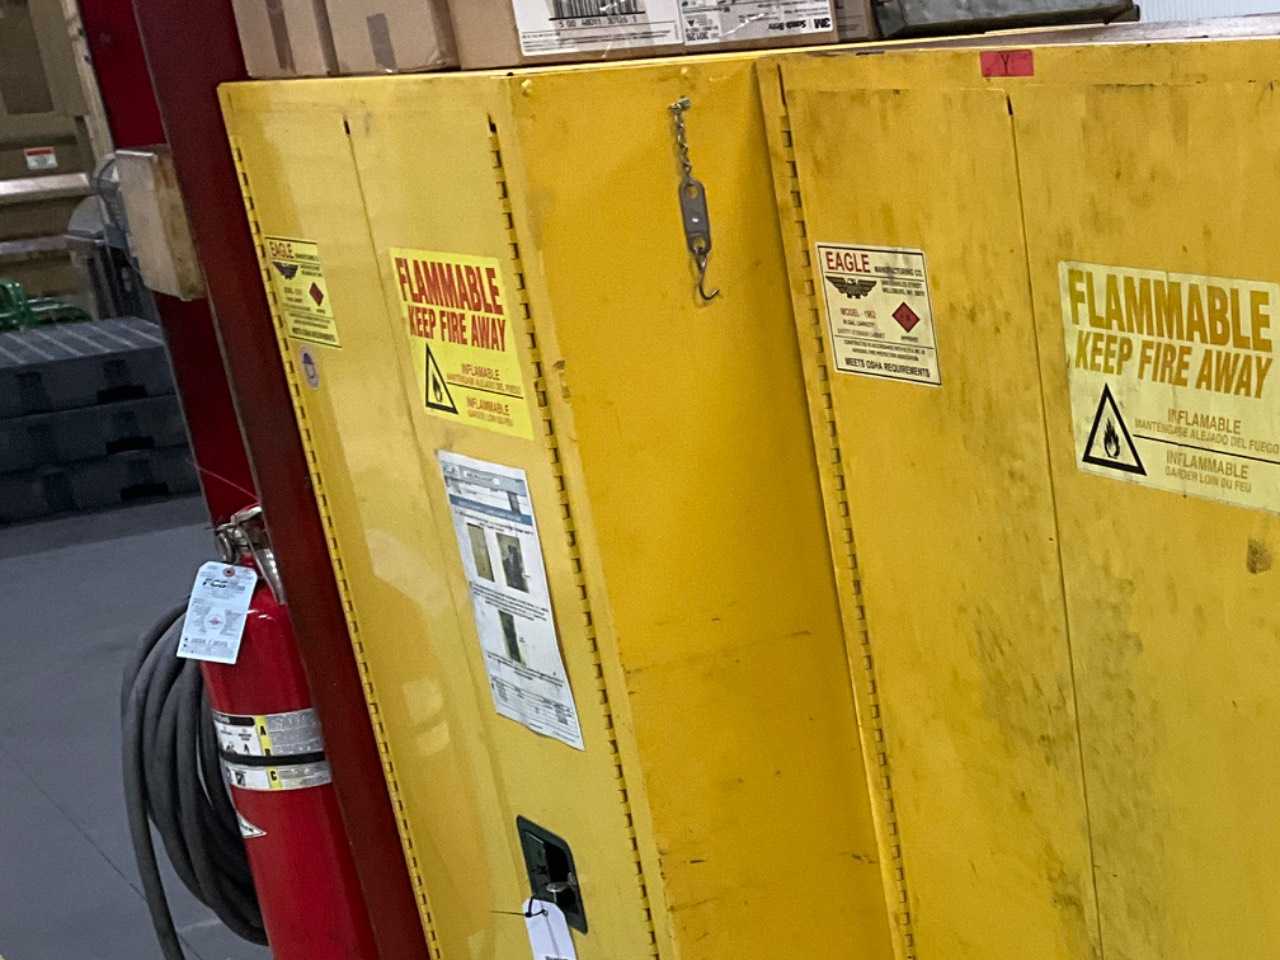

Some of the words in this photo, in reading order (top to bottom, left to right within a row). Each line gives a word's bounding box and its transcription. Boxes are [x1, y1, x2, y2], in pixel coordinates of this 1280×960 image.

[825, 251, 871, 273] EAGLE
[395, 257, 504, 315] FLAMMABLE
[1068, 269, 1272, 352] FLAMMABLE
[408, 305, 436, 339] KEEP
[439, 310, 467, 345] FIRE
[471, 314, 505, 352] AWAY
[1075, 330, 1133, 375] KEEP
[1138, 339, 1192, 387] FIRE
[1195, 348, 1272, 399] AWAY
[1167, 407, 1241, 435] INFLAMABLE
[1190, 428, 1229, 445] ALEJADO
[1230, 437, 1247, 449] DEL
[1250, 440, 1280, 455] FUEGO
[1166, 450, 1249, 480] INFLAMMABLE
[1200, 474, 1218, 487] LOIN
[1235, 480, 1252, 493] FEU
